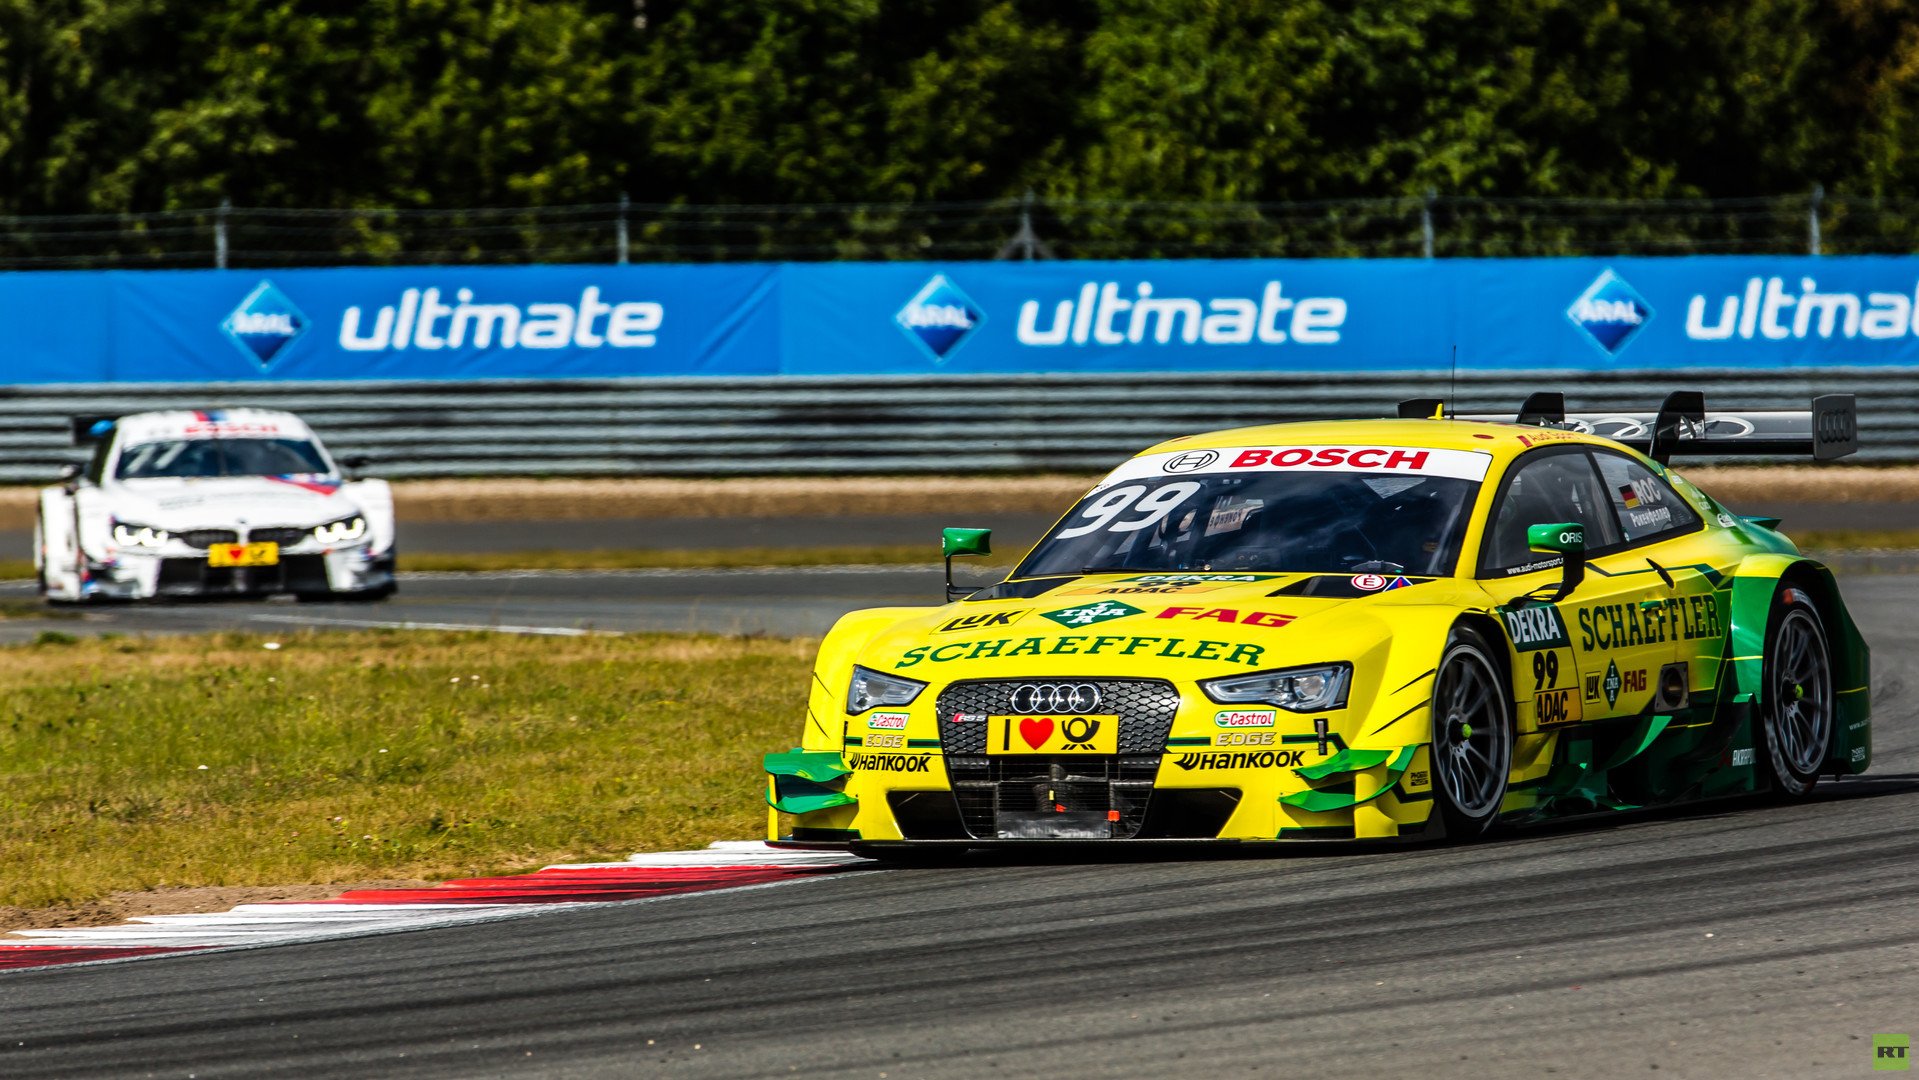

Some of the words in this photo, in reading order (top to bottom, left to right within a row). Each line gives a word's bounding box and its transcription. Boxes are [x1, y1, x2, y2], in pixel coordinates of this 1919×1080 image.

[339, 286, 664, 351] ultimate
[904, 303, 972, 330] ARAL
[1016, 280, 1347, 345] ultimate
[1578, 300, 1643, 325] ARAL
[1686, 277, 1919, 340] ultima
[1229, 448, 1430, 470] BOSCH
[1631, 477, 1662, 505] ROC
[1056, 481, 1201, 540] 99
[1560, 532, 1583, 544] ORIS
[1097, 587, 1183, 595] ADAC
[1155, 607, 1298, 627] FAG
[1506, 606, 1561, 644] DEKRA
[1578, 594, 1721, 653] SCHAEFFLER
[895, 636, 1265, 668] SCHAEFFLER
[1533, 650, 1559, 690] 99
[1623, 669, 1647, 694] FAG
[876, 714, 907, 727] Castrol
[1230, 712, 1274, 726] Castrol
[1537, 691, 1568, 723] ADAC
[866, 734, 905, 748] EDGE
[1215, 732, 1277, 746] EDGE
